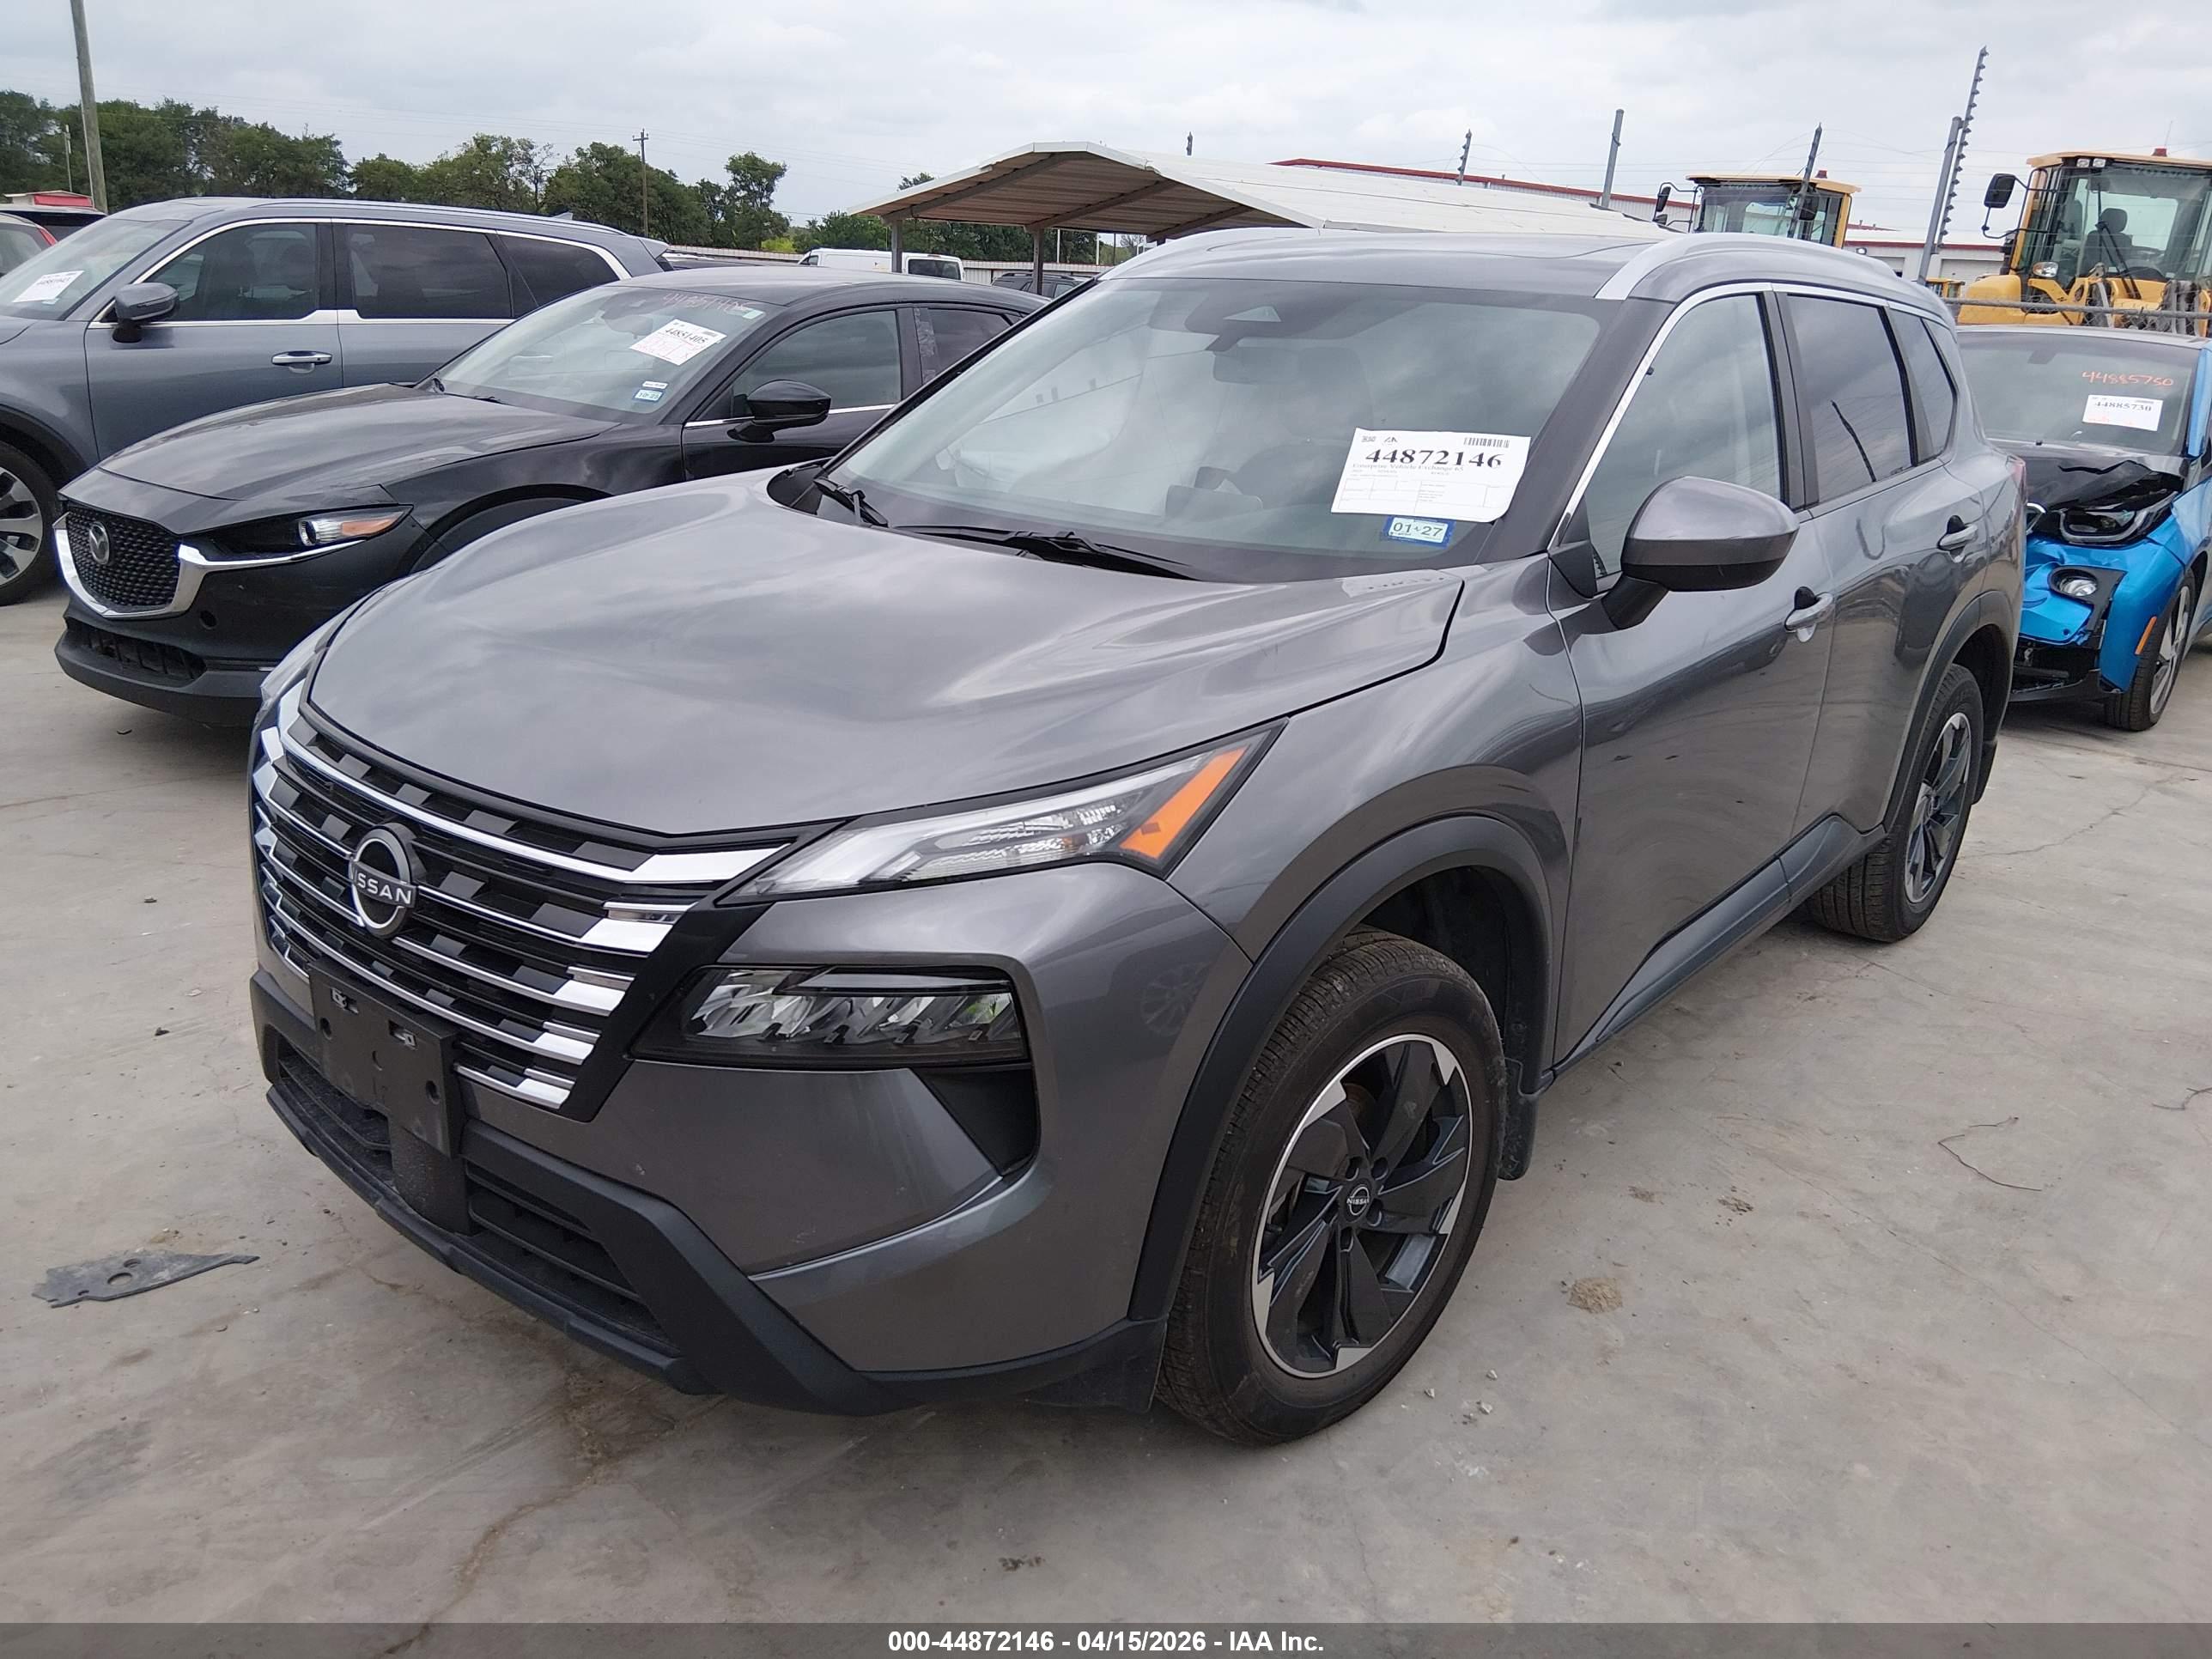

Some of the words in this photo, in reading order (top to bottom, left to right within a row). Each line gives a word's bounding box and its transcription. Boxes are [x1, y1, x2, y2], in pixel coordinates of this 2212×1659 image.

[2094, 401, 2152, 411] 44885730
[1365, 448, 1504, 469] 44872146
[1393, 522, 1412, 533] 01
[1421, 526, 1443, 537] 27
